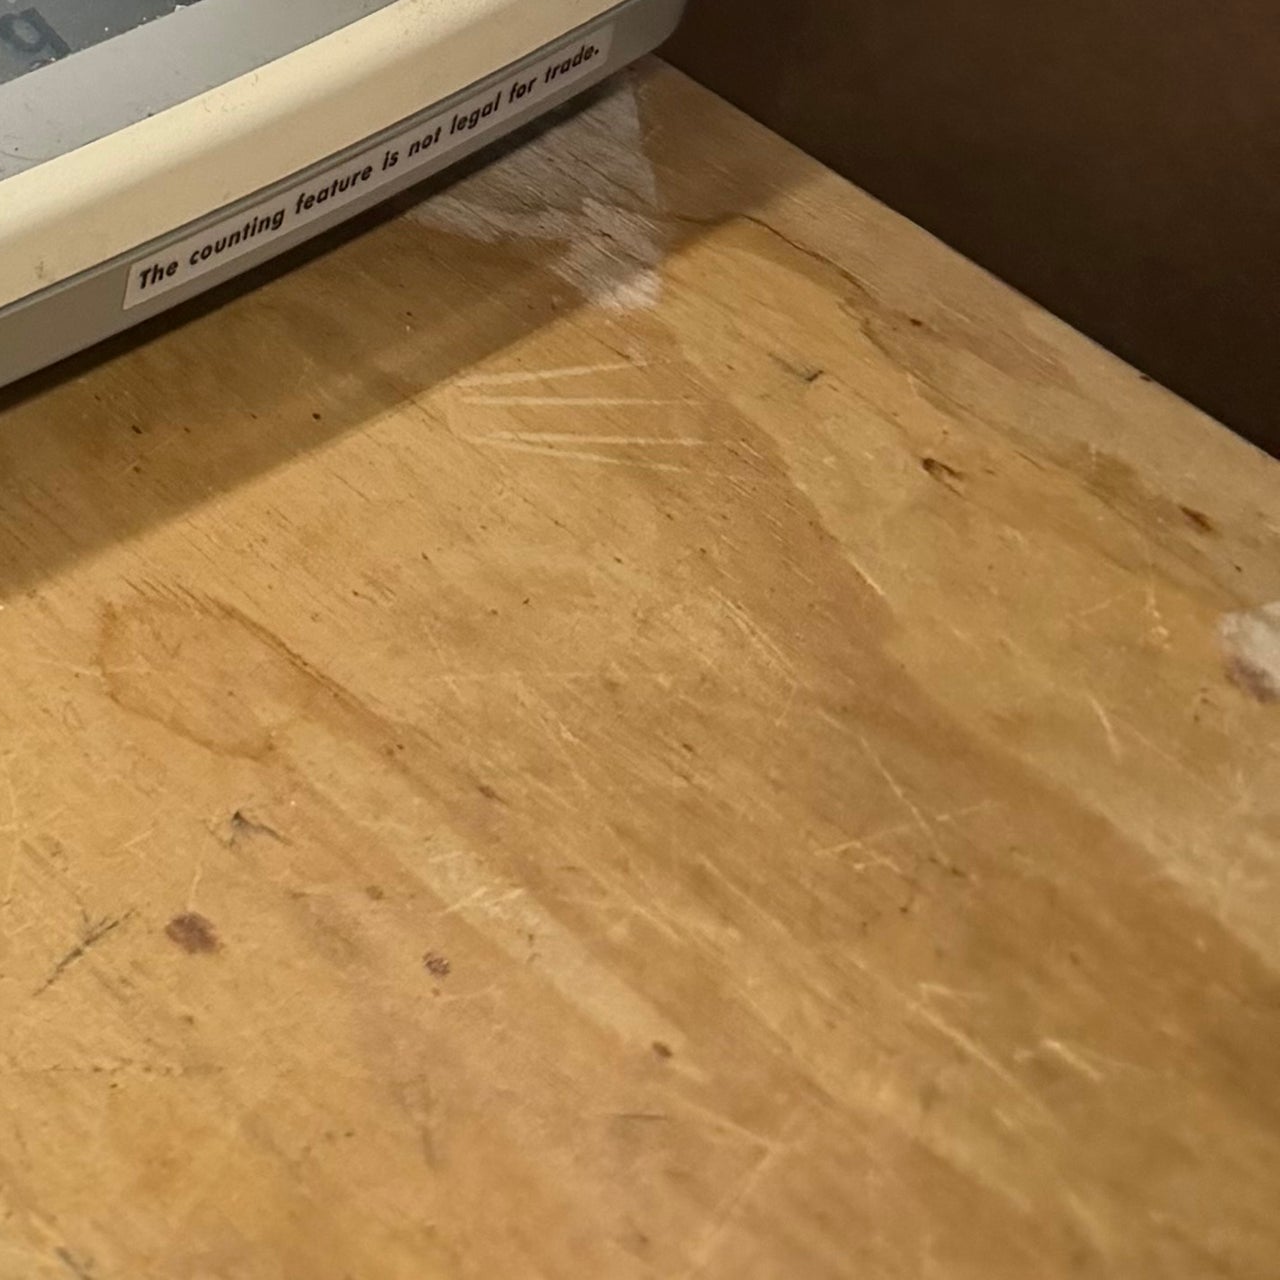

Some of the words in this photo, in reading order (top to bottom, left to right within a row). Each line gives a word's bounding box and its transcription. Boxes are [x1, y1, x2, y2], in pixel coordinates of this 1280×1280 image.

[139, 259, 178, 290] The
[189, 208, 285, 267] counting
[295, 165, 373, 215] feature
[382, 150, 399, 171] is
[408, 126, 441, 157] not
[450, 92, 501, 135] legal
[509, 76, 537, 104] for
[544, 43, 600, 83] trade.
